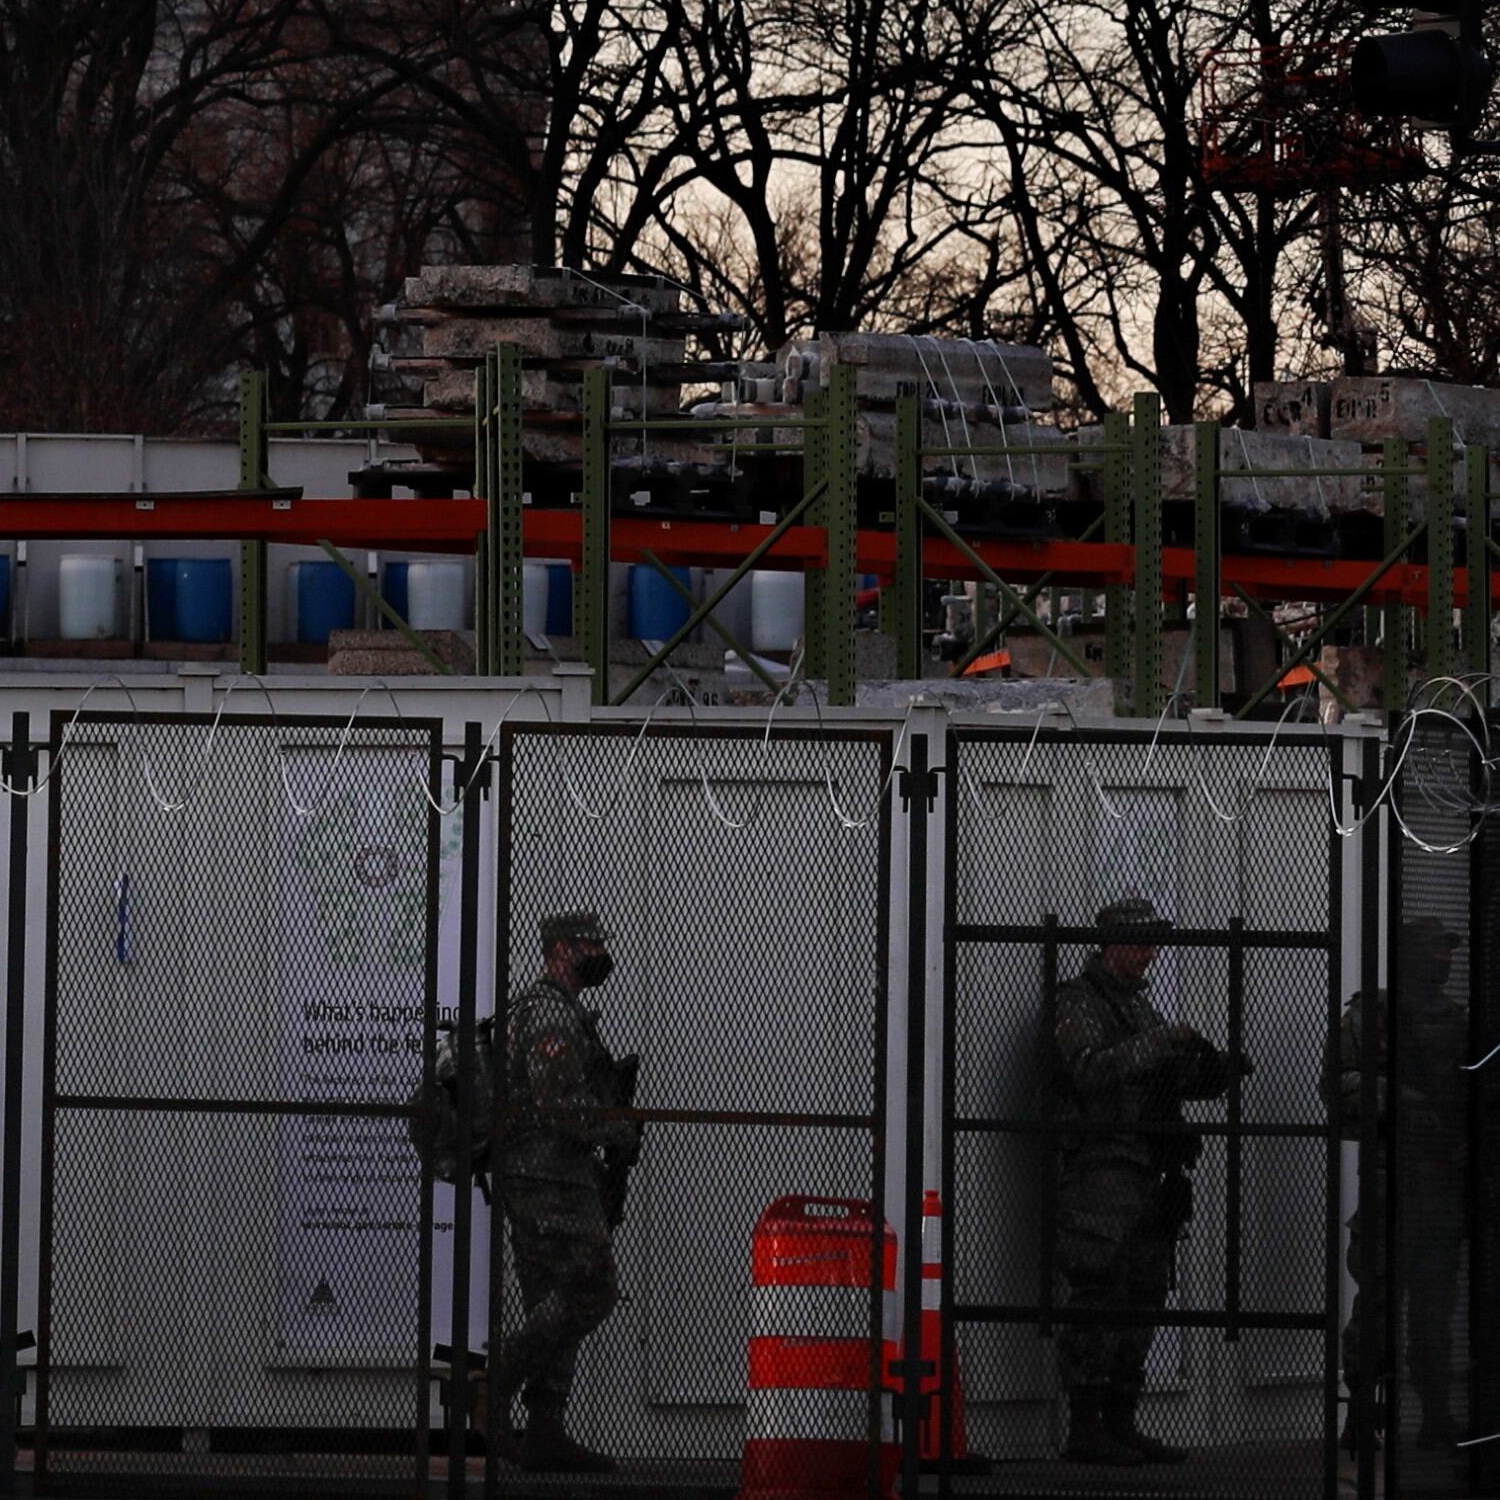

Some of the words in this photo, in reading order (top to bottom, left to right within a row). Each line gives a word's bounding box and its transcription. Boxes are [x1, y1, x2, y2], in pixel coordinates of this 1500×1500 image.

[303, 999, 365, 1023] What's
[303, 1032, 364, 1055] behind
[369, 1032, 398, 1055] the
